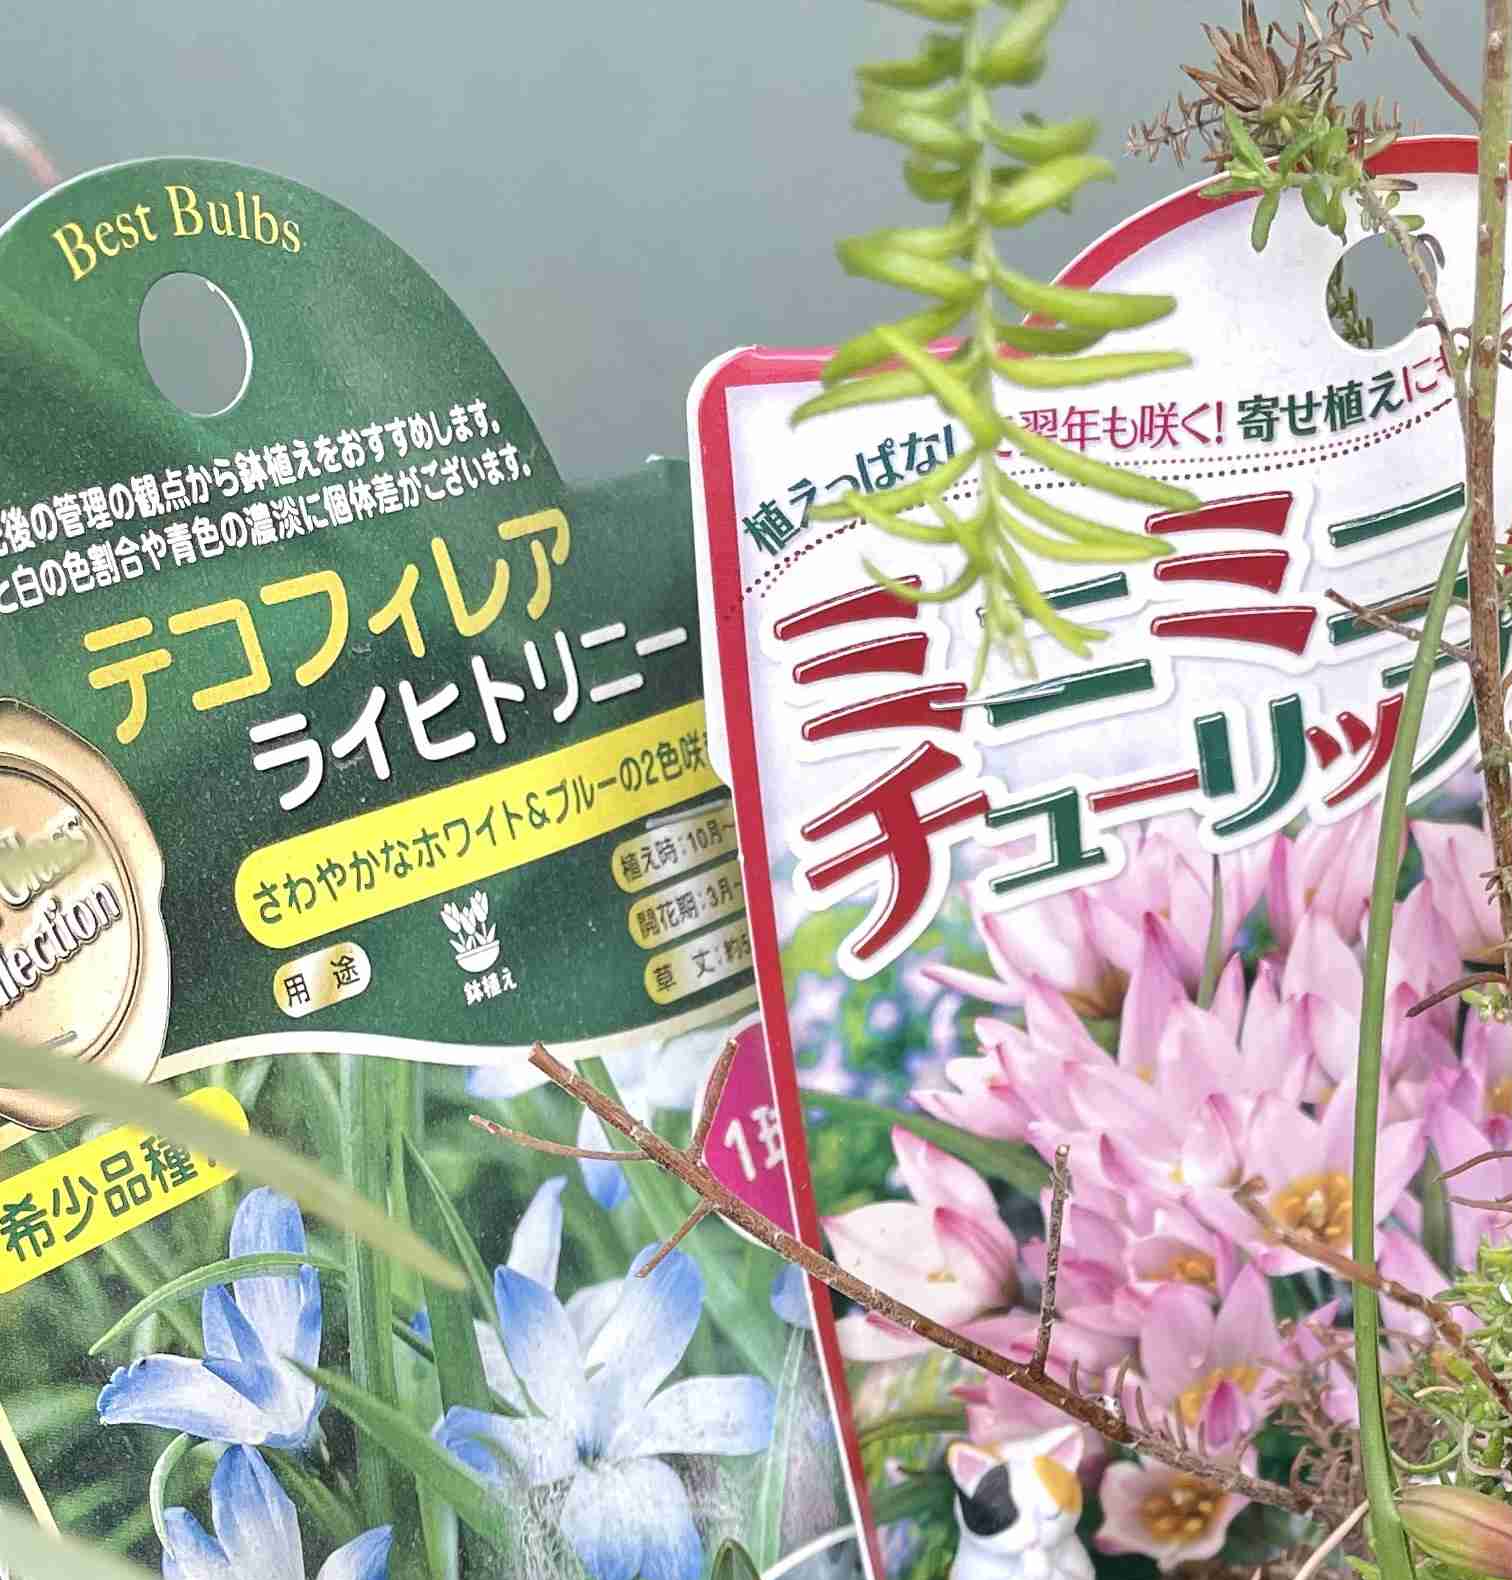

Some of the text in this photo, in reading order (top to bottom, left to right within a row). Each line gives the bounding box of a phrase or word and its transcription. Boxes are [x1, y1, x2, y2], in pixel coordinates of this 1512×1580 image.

[53, 184, 302, 281] Best Bulbs
[0, 398, 500, 557] 後の管理の観点から鉢植えをおすすめします。
[84, 508, 571, 744] テコフィレア
[249, 626, 689, 811] ライヒトリニー
[251, 728, 707, 927] さわやかなホワイト&ブルーの2色咲
[464, 969, 518, 1005] 鉢植え
[0, 1134, 216, 1262] 希少品種
